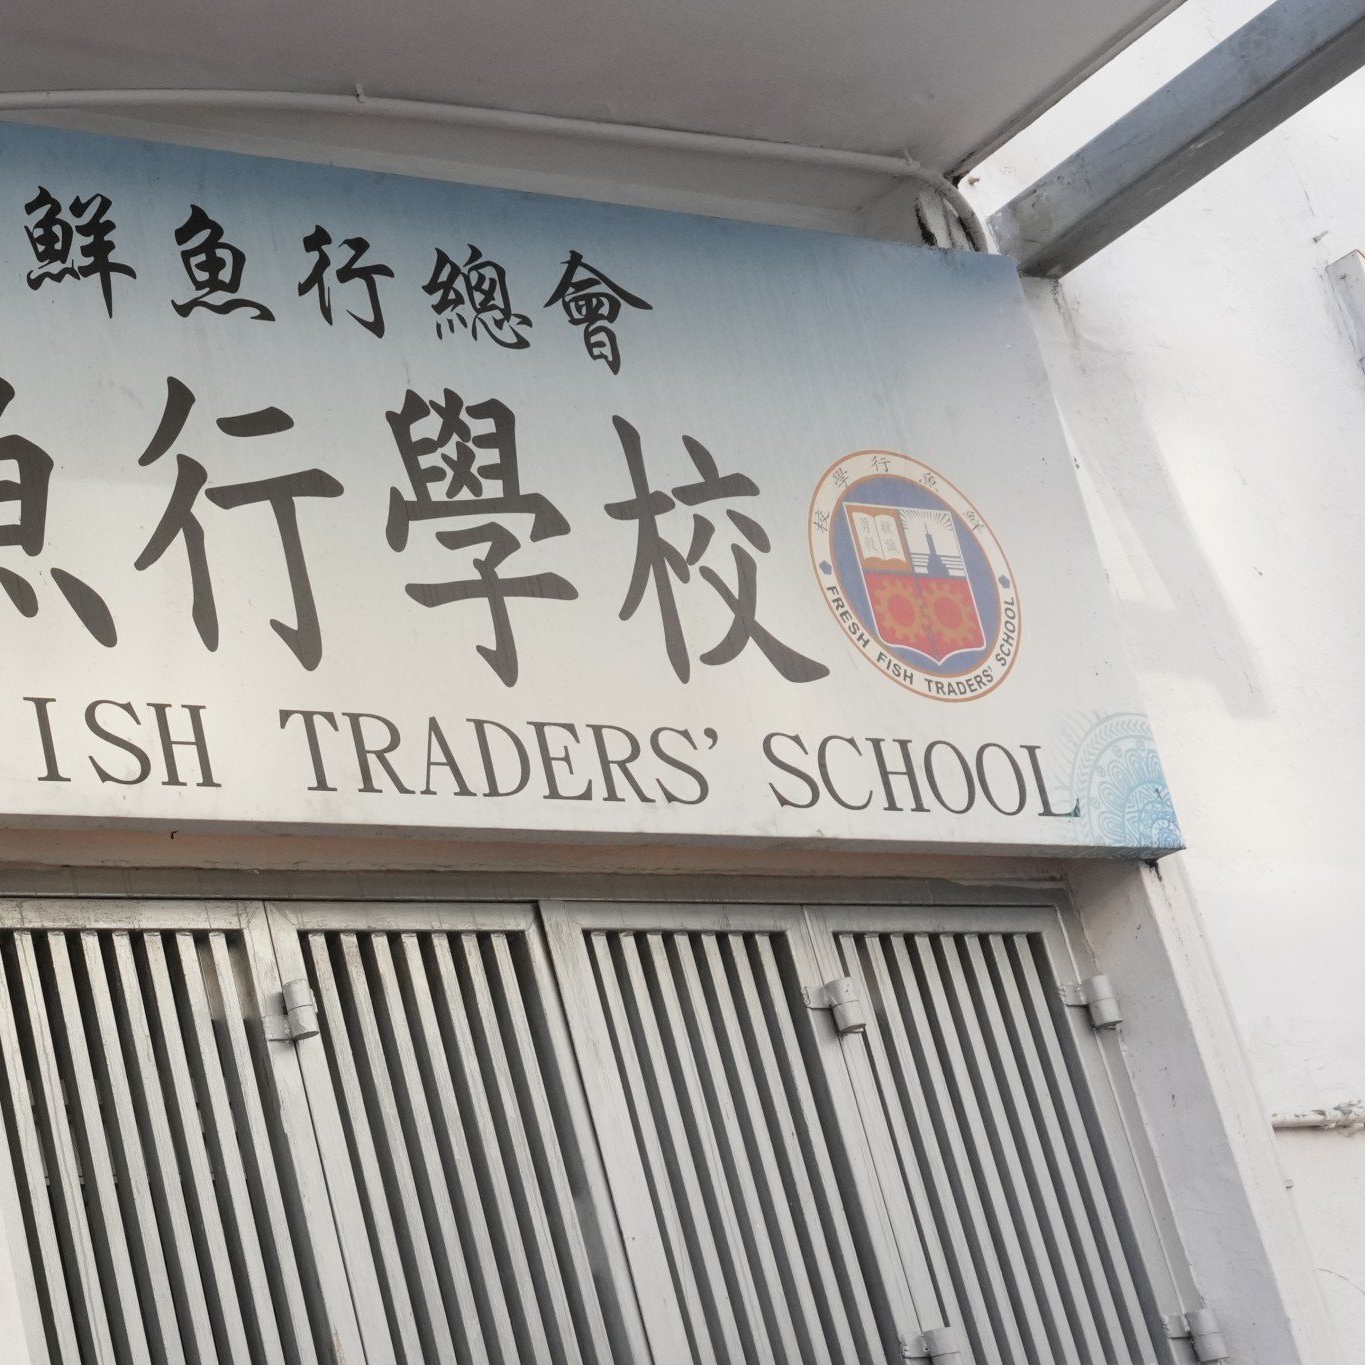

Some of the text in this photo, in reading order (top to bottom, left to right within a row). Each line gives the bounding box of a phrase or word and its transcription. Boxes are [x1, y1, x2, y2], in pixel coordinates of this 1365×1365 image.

[826, 585, 870, 649] FRESH
[877, 651, 915, 686] FISH
[994, 595, 1017, 668] SCHOOL
[762, 731, 1083, 819] SCHOOL
